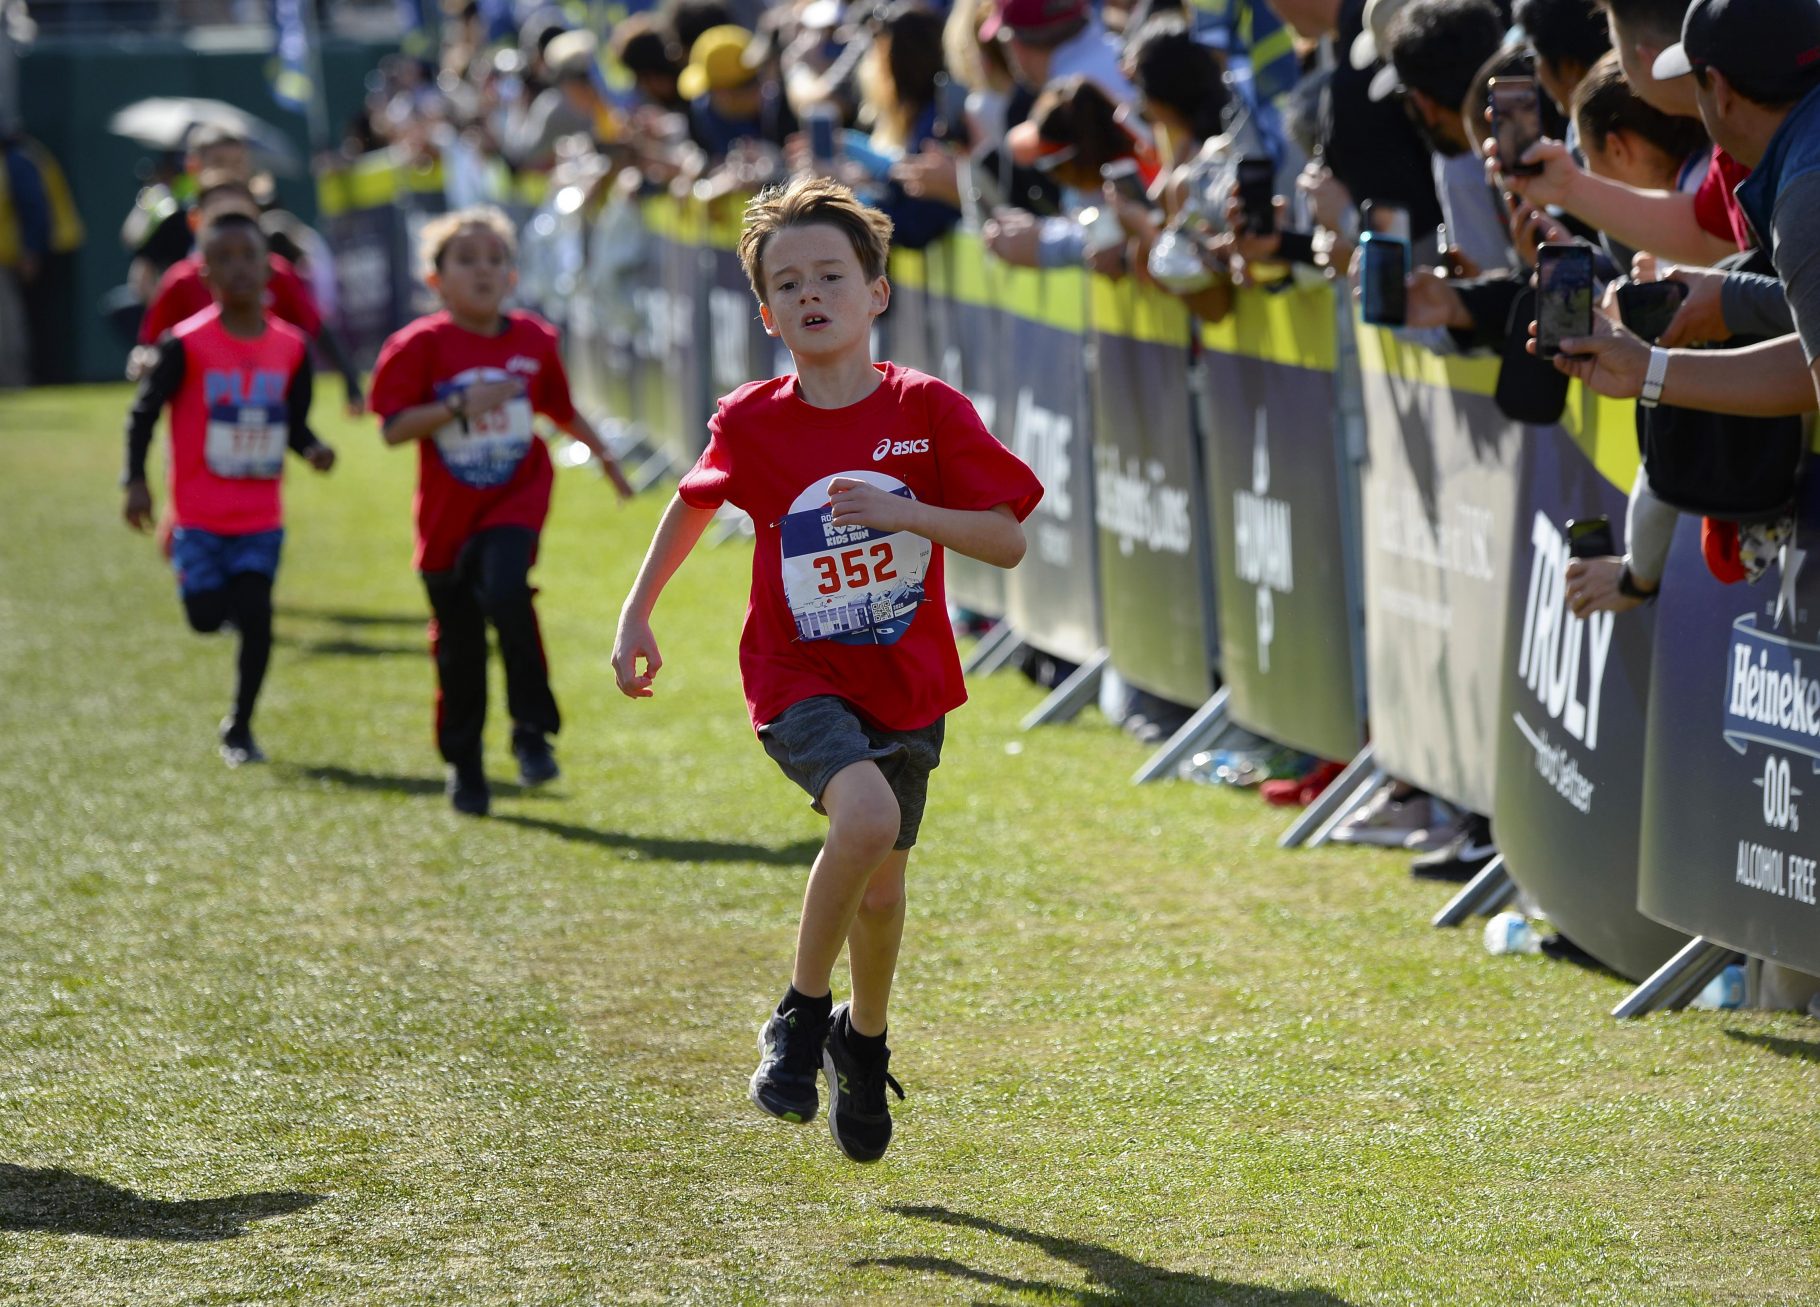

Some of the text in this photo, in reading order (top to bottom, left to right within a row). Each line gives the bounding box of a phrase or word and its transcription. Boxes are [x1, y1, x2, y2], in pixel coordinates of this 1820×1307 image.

[812, 542, 898, 595] 352
[826, 529, 869, 547] KIDS RUN
[1518, 510, 1615, 750] TRULY
[1730, 643, 1820, 738] Heineke
[1735, 840, 1817, 906] ALCOHOL FREE
